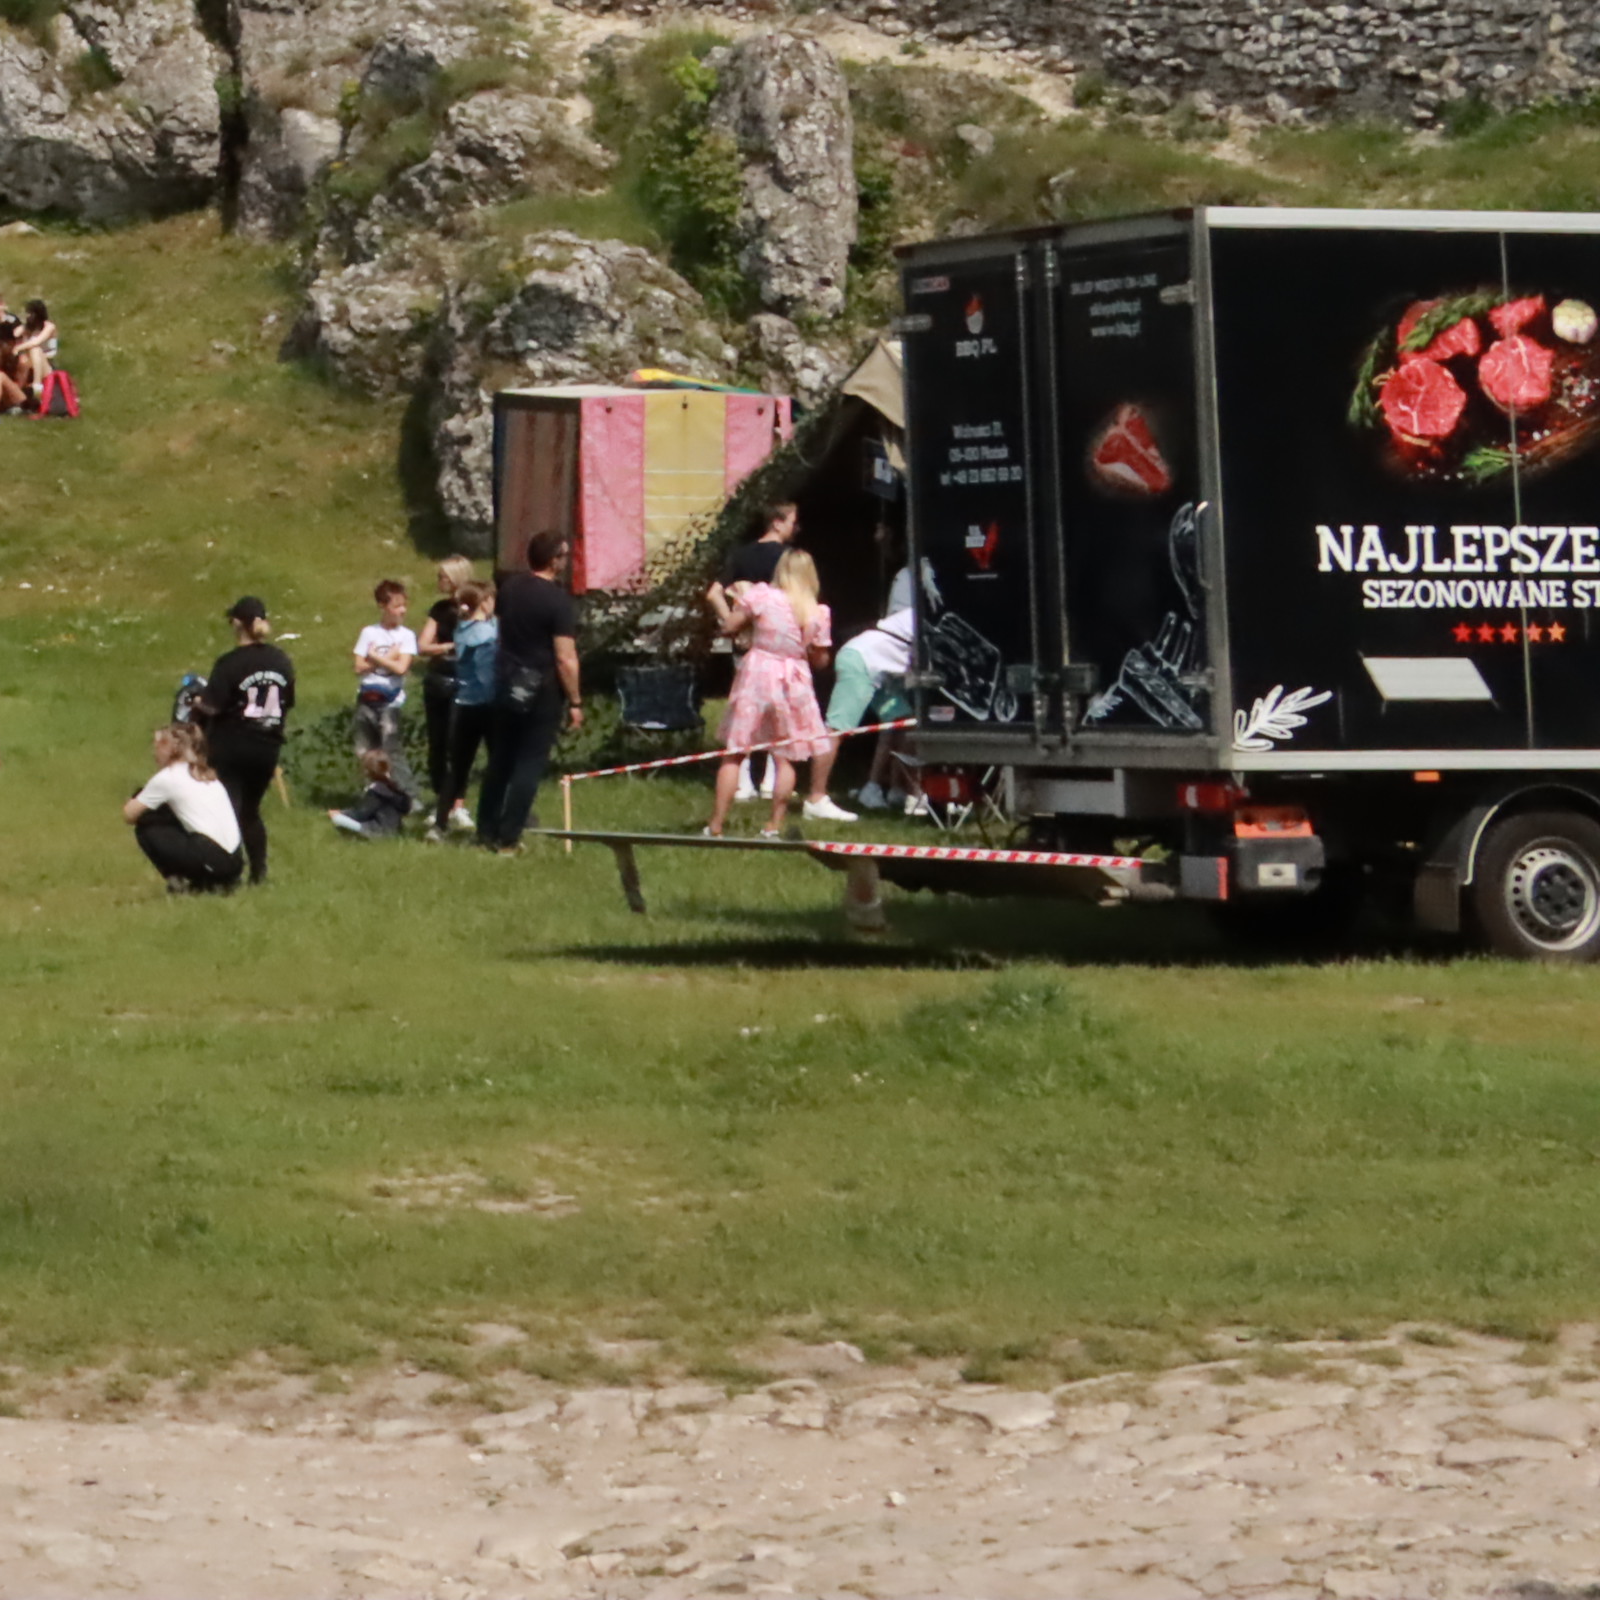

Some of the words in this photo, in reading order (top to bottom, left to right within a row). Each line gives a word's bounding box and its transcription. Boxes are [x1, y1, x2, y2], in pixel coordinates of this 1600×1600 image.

[1315, 524, 1600, 573] NAJLEPSZE
[1362, 579, 1568, 608] SEZONOWANE
[244, 684, 282, 718] LA
